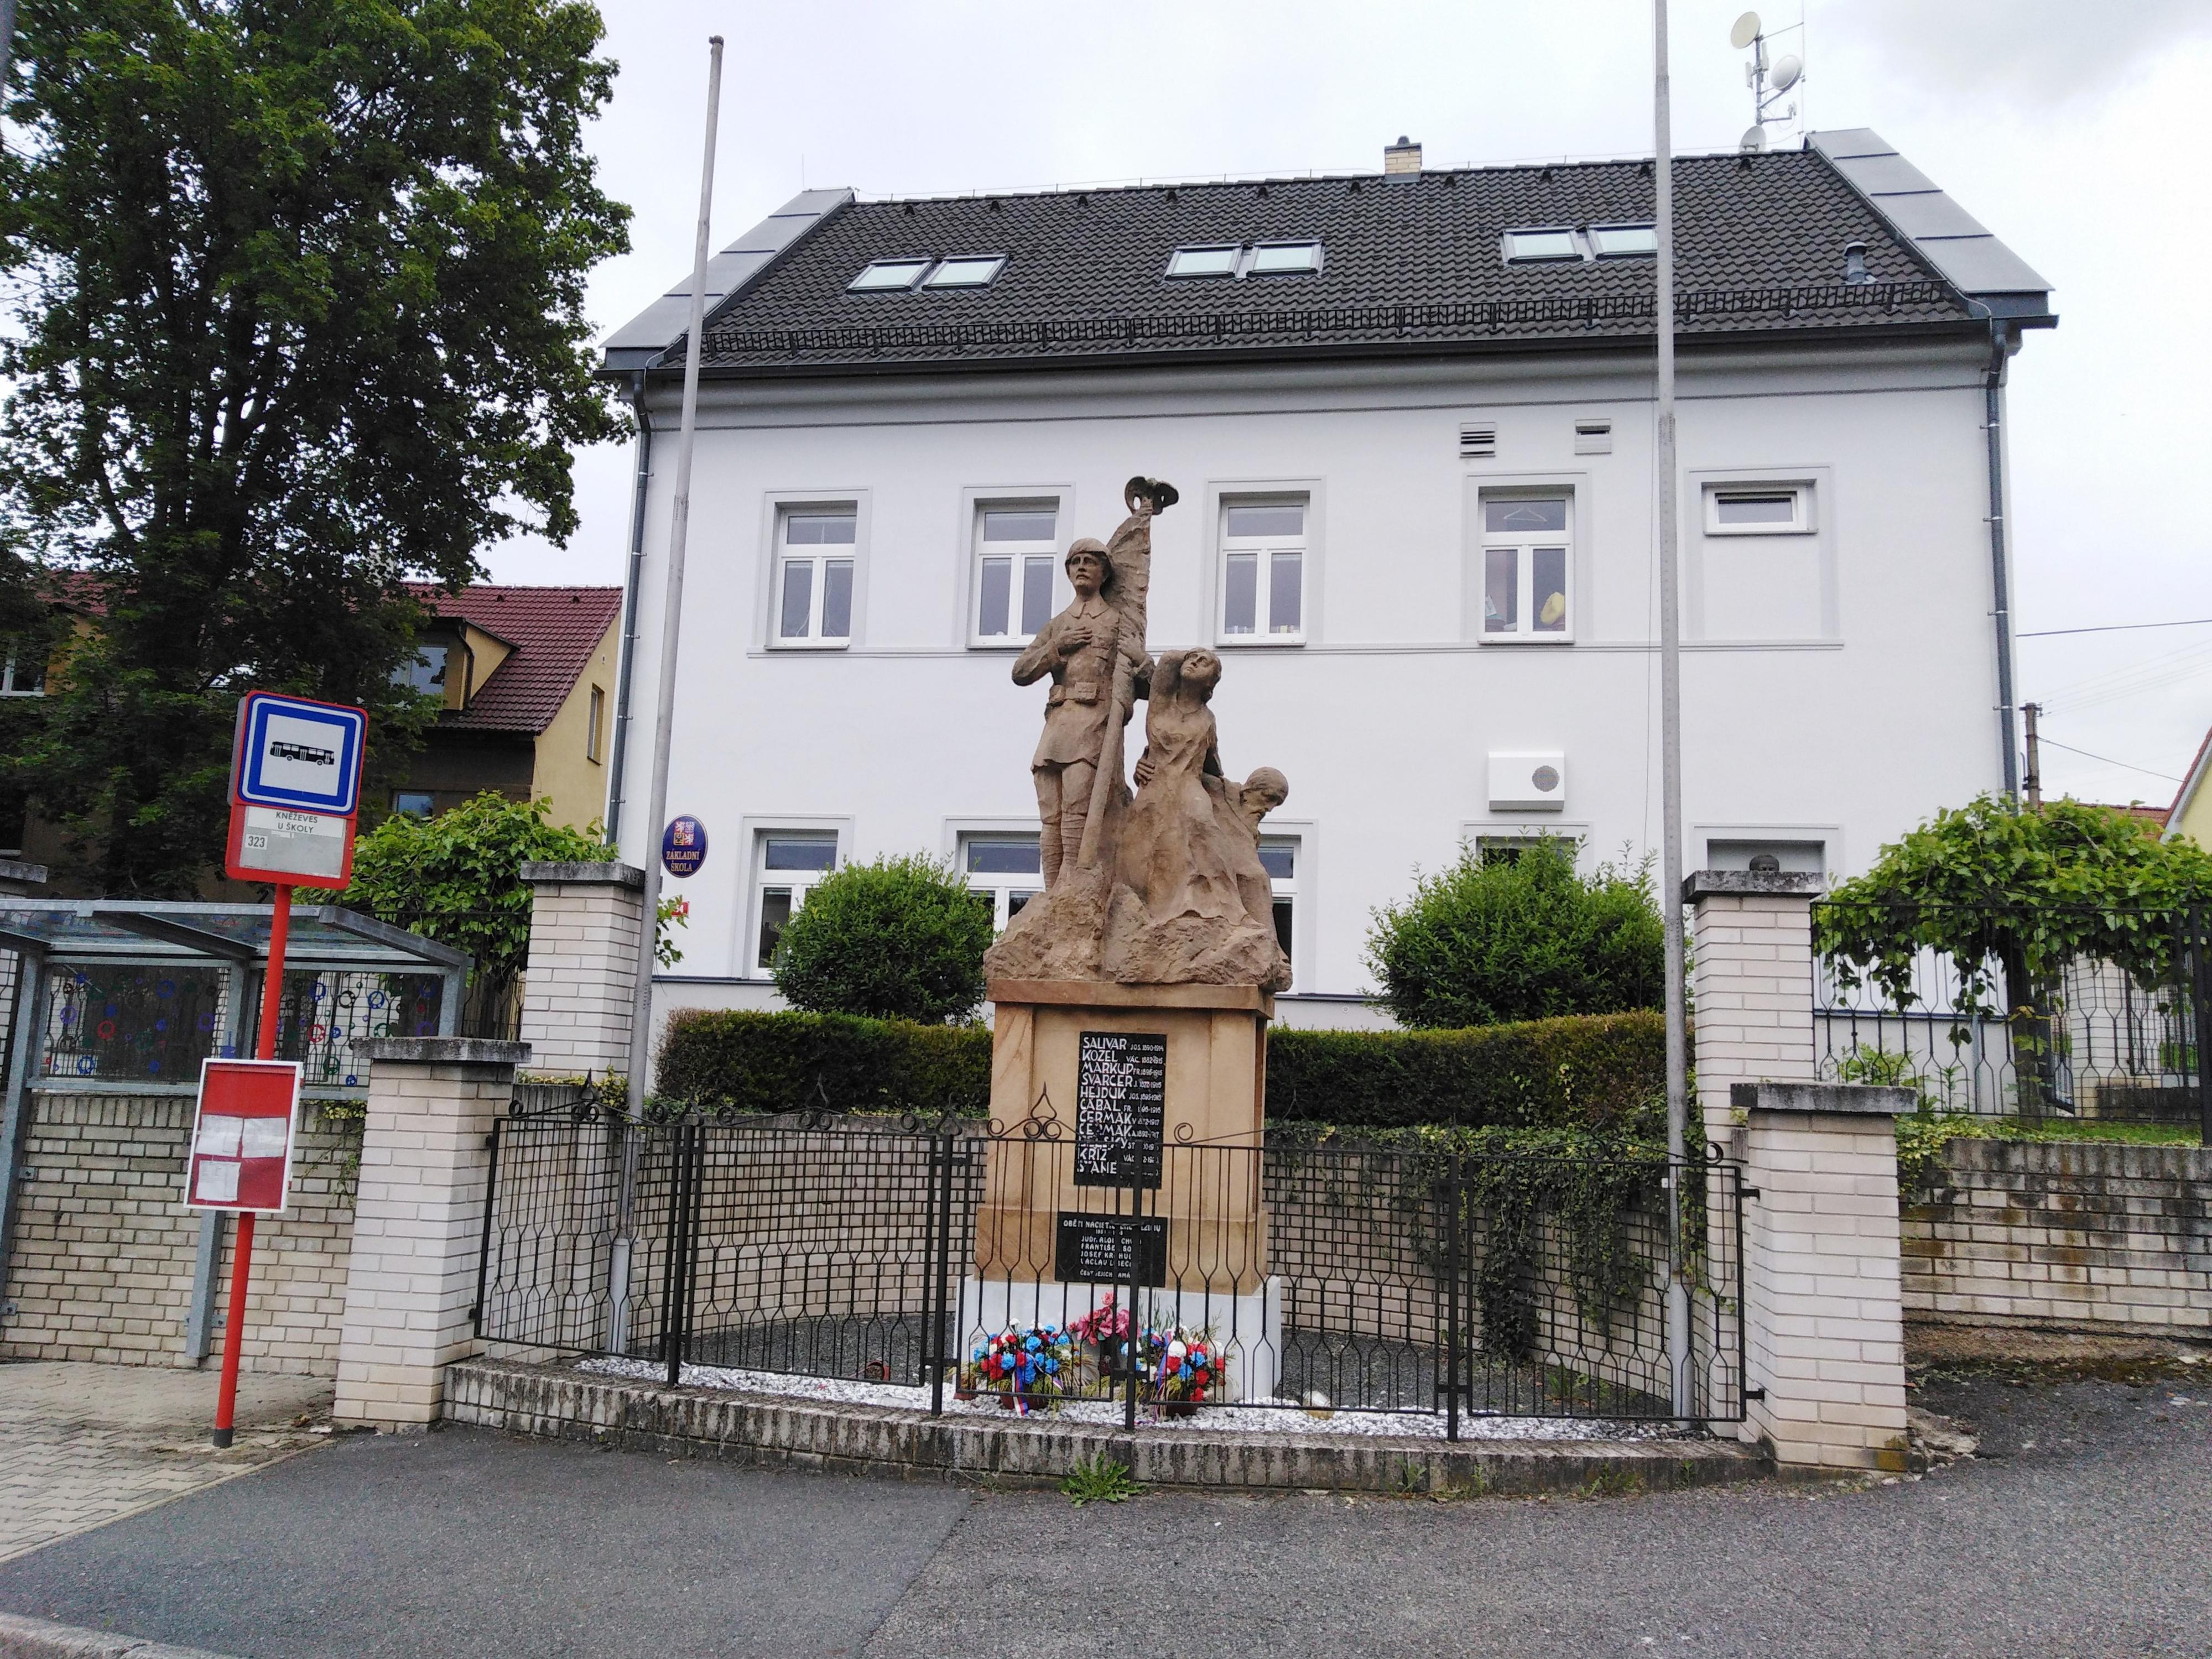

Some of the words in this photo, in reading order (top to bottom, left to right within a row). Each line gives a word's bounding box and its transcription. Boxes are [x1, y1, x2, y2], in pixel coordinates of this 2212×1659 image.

[286, 822, 314, 833] ŠKOLY
[248, 836, 265, 847] 323
[666, 848, 700, 860] ZÁKLADNÍ
[670, 860, 693, 872] ŠKOLA
[1082, 1049, 1118, 1062] KOZEL
[1081, 1061, 1134, 1074] MARKUP
[1080, 1086, 1127, 1099] HEJDUK
[1081, 1243, 1116, 1251] FRANTIŠE
